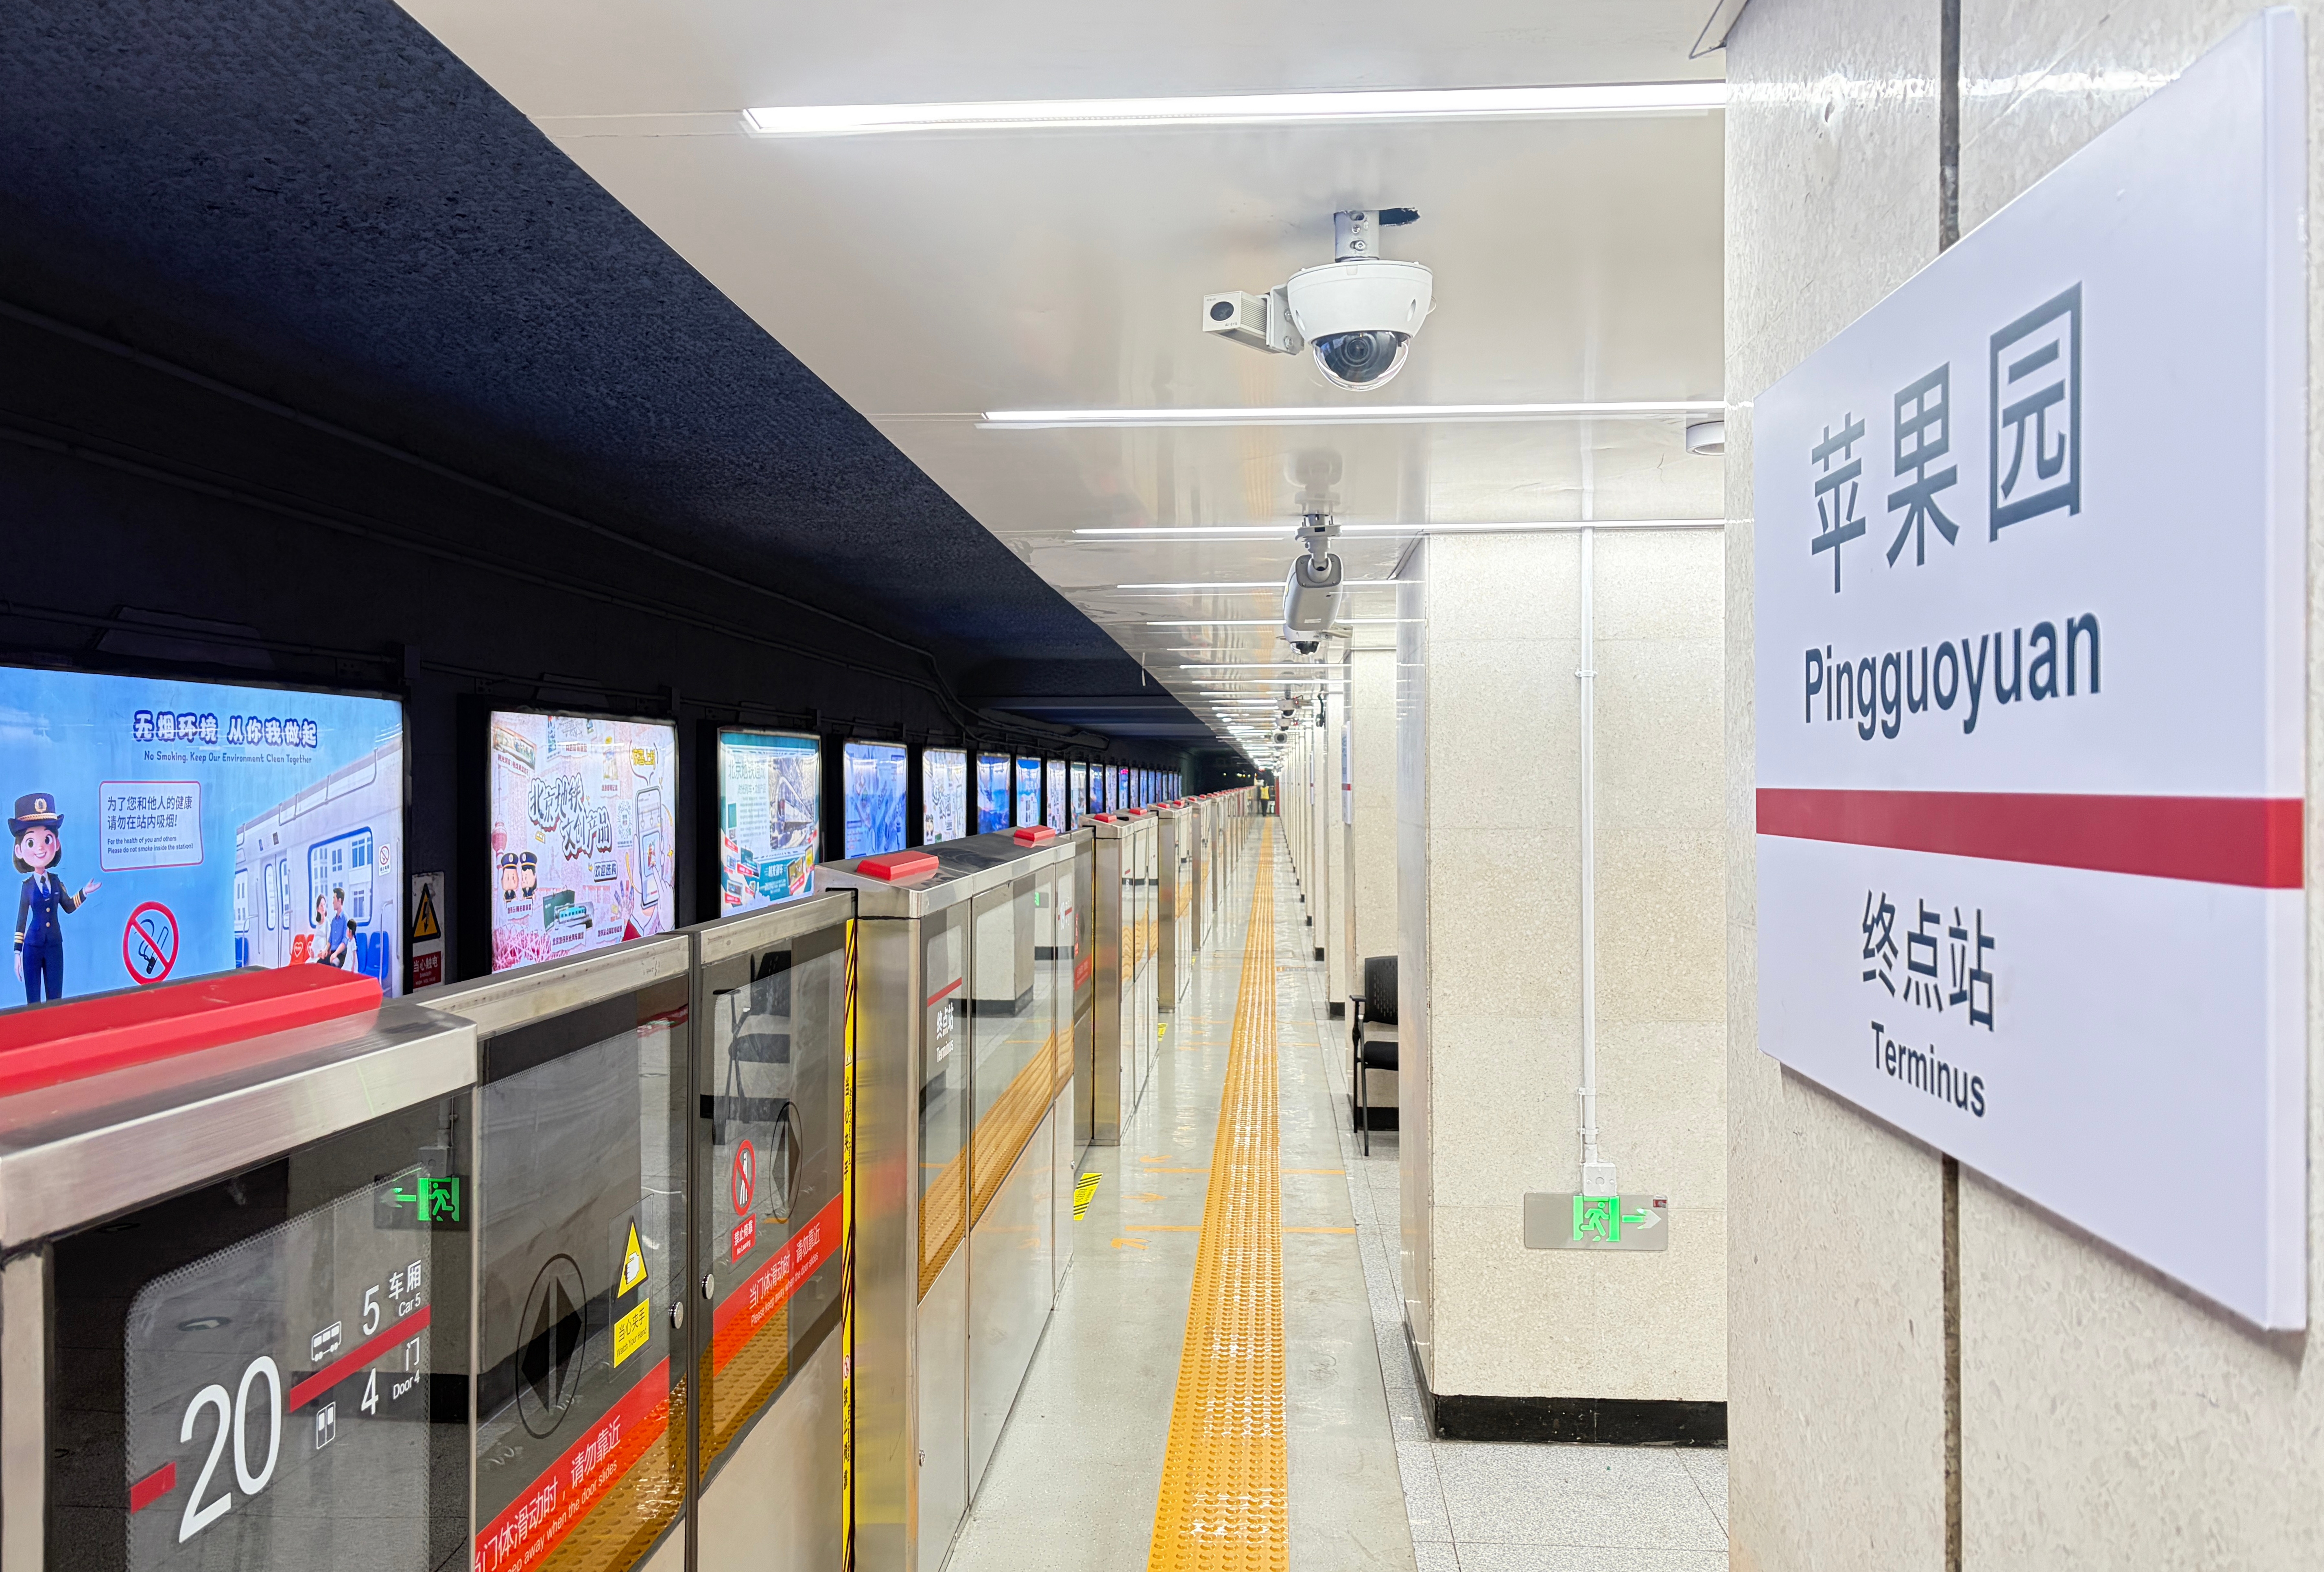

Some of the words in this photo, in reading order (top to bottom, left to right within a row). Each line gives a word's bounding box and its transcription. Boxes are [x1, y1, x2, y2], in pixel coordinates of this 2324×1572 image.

[1810, 280, 2085, 595] 苹果园
[1804, 610, 2103, 742] Pingguoyuan
[134, 710, 218, 744] 无烟环境
[227, 715, 317, 748] 从你我做起
[144, 751, 154, 760] No
[190, 752, 206, 764] Keep
[209, 753, 220, 761] Our
[223, 753, 264, 763] Environment
[266, 754, 284, 763] Clean
[286, 755, 312, 765] Together
[108, 796, 192, 811] 为了您和他人的健康
[529, 773, 584, 826] 北京地铁
[561, 808, 611, 854] 文创产品
[413, 955, 438, 972] 当心触电
[1861, 889, 1996, 1034] 终点站
[937, 1002, 954, 1040] 终点站
[937, 1039, 953, 1063] Terminus
[1870, 1020, 1986, 1119] Terminus
[741, 1240, 751, 1252] Leaning
[389, 1259, 422, 1301] 车厢
[362, 1284, 380, 1336] 5
[398, 1297, 413, 1317] Car
[415, 1293, 422, 1307] 5
[751, 1307, 764, 1327] Please
[765, 1297, 774, 1312] keep
[775, 1286, 785, 1302] away
[785, 1277, 794, 1291] when
[617, 1343, 628, 1357] Watch
[629, 1336, 637, 1347] Your
[638, 1325, 647, 1340] Hand
[619, 1307, 645, 1342] 当心夹手
[406, 1337, 420, 1371] 门
[360, 1368, 379, 1415] 4
[392, 1378, 412, 1400] Door
[413, 1369, 421, 1383] 4
[179, 1356, 282, 1544] 20
[524, 1533, 545, 1565] away
[547, 1511, 567, 1541] when
[568, 1498, 580, 1521] the
[581, 1481, 597, 1504] door
[598, 1459, 617, 1487] slides
